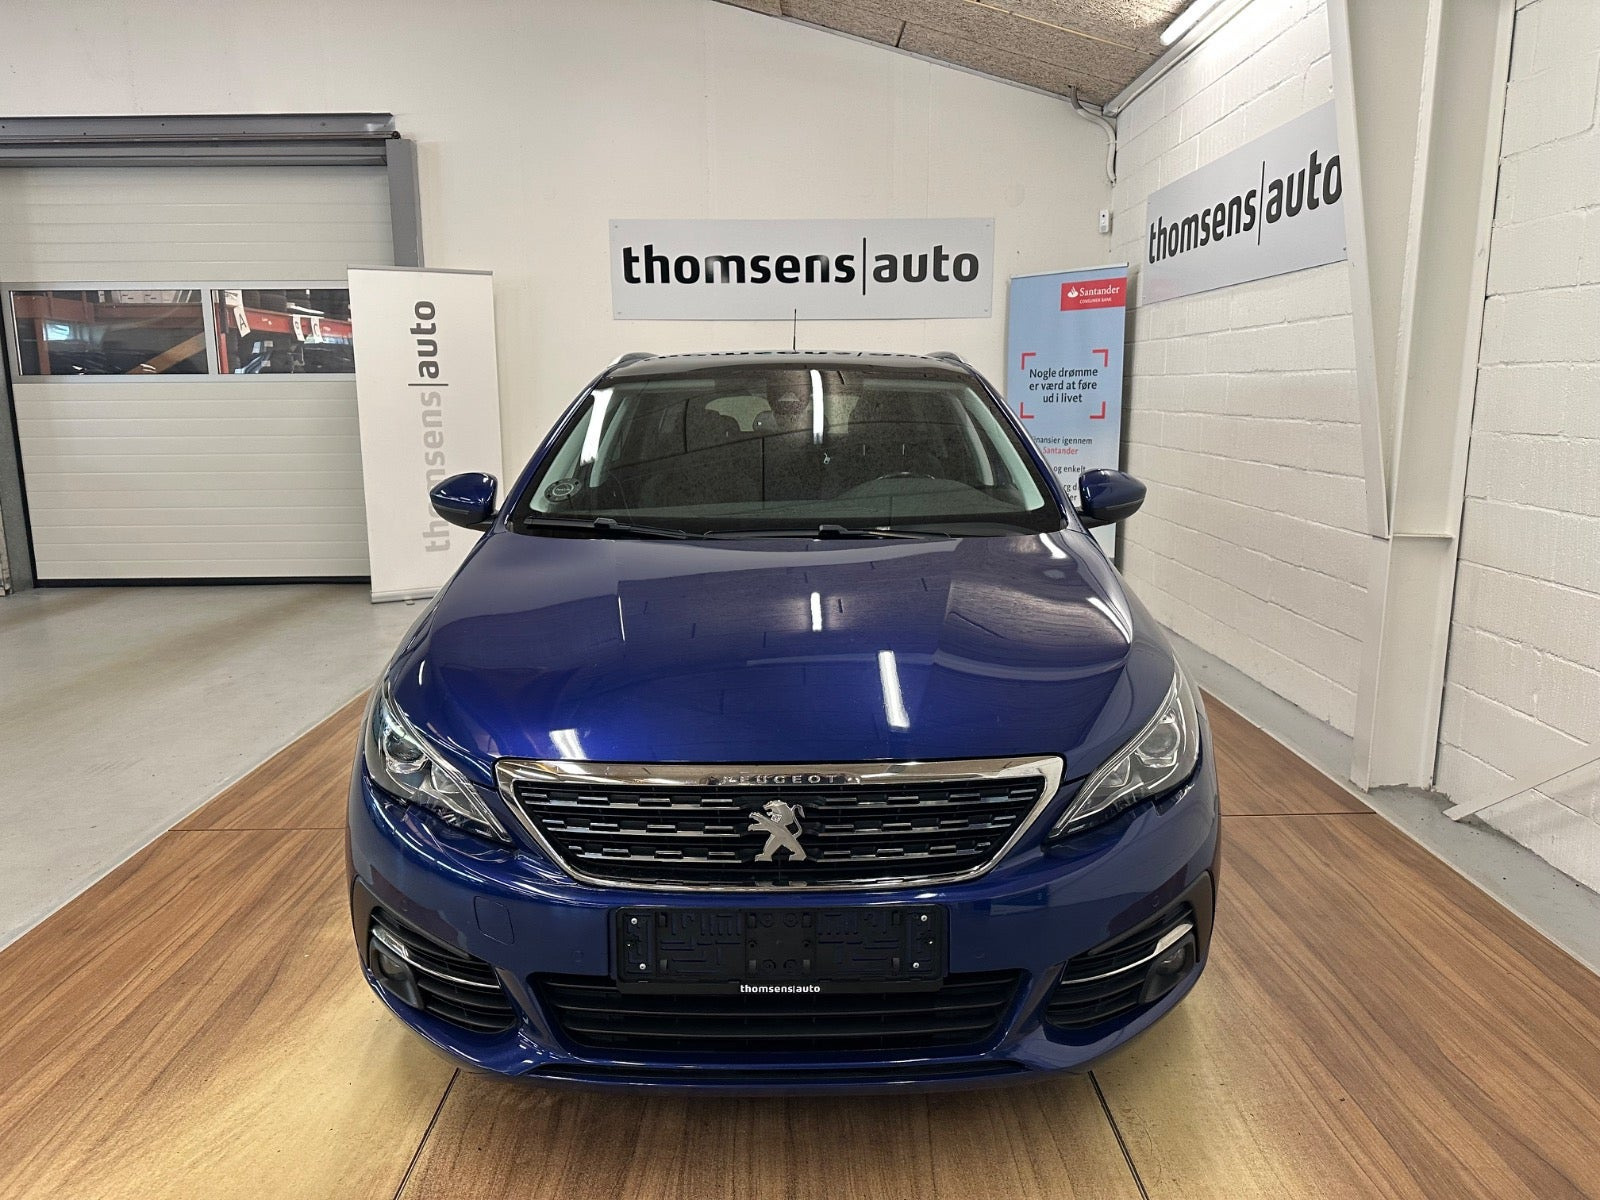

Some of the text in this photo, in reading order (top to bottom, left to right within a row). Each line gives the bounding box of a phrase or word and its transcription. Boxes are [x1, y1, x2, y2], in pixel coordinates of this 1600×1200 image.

[1079, 284, 1120, 297] Santander
[1029, 367, 1098, 380] Nogle drømme
[1029, 379, 1098, 391] er værd at føre
[1043, 393, 1054, 403] ud
[1061, 393, 1083, 403] livet
[1032, 435, 1093, 446] inansier igennem
[1042, 446, 1079, 455] Santander
[1053, 466, 1062, 474] og
